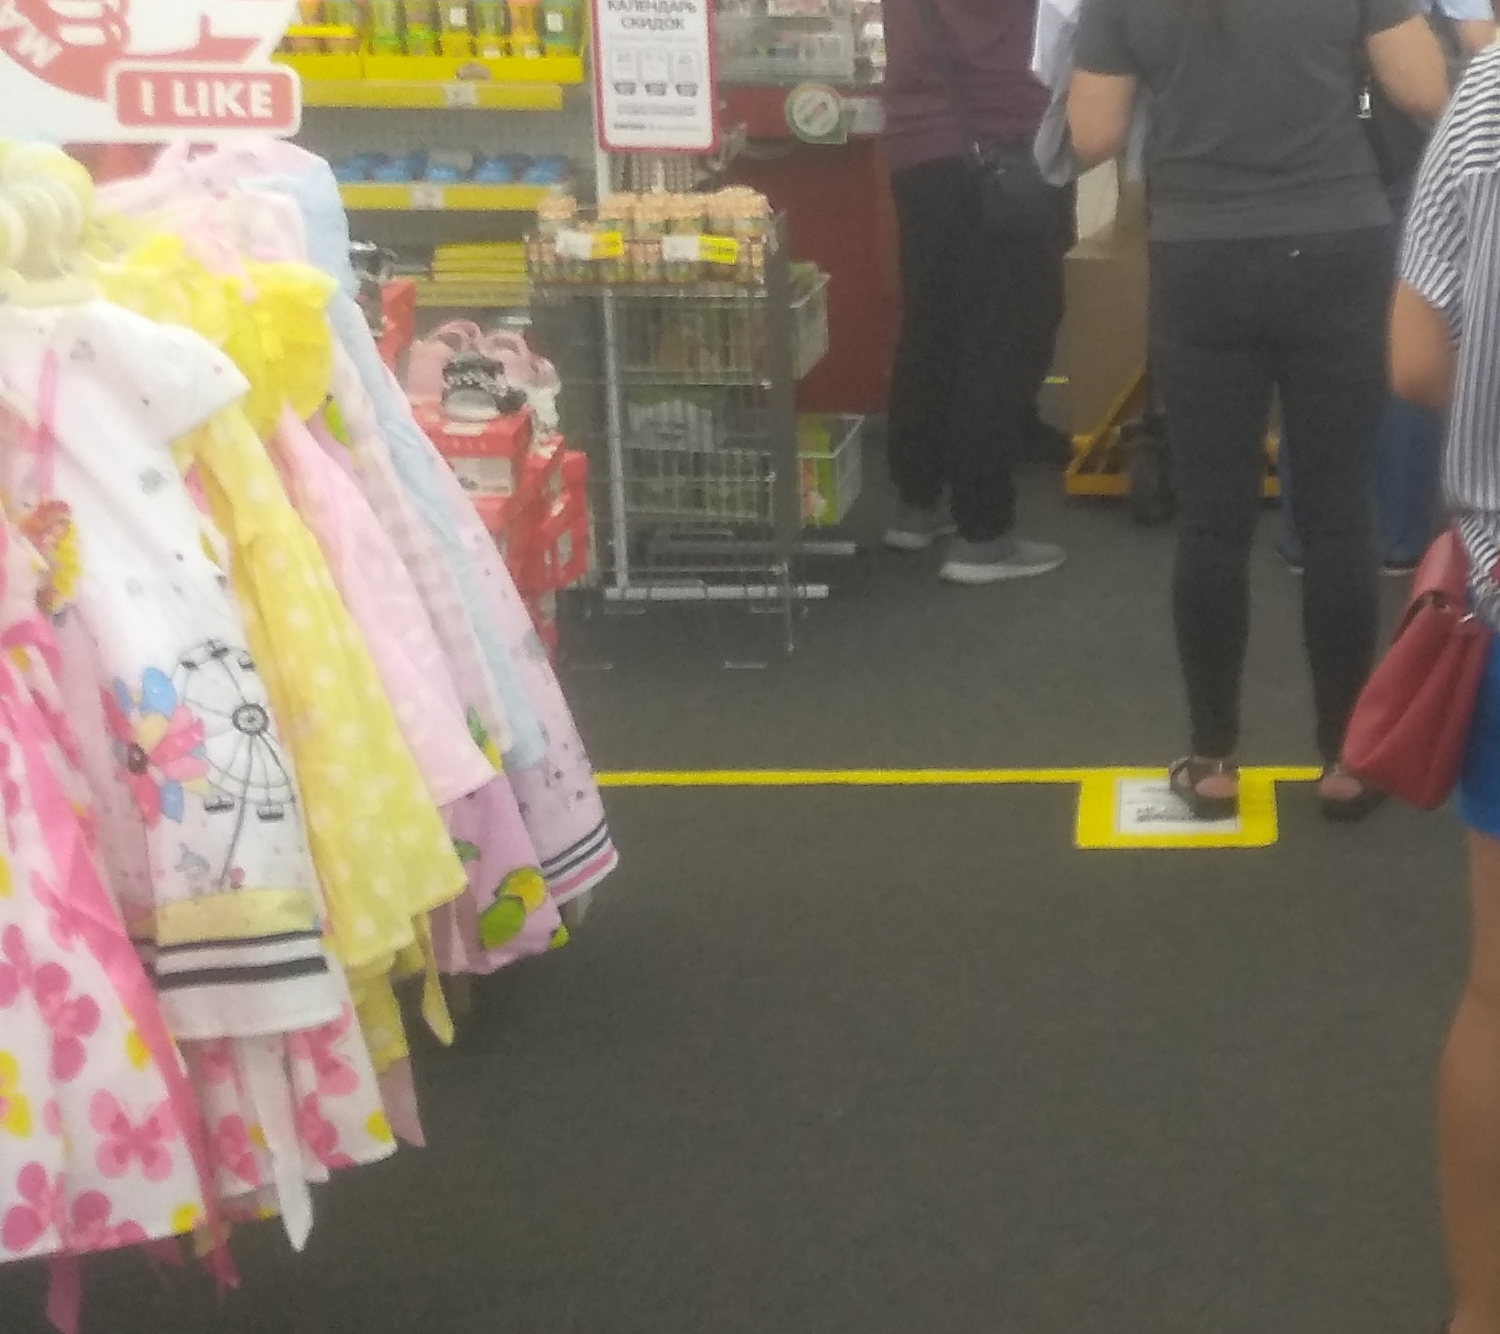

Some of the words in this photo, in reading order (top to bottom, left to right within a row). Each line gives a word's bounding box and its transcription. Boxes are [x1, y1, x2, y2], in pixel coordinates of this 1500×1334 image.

[621, 17, 685, 31] СКИДОК
[139, 79, 155, 117] I
[172, 79, 274, 118] LIKE
